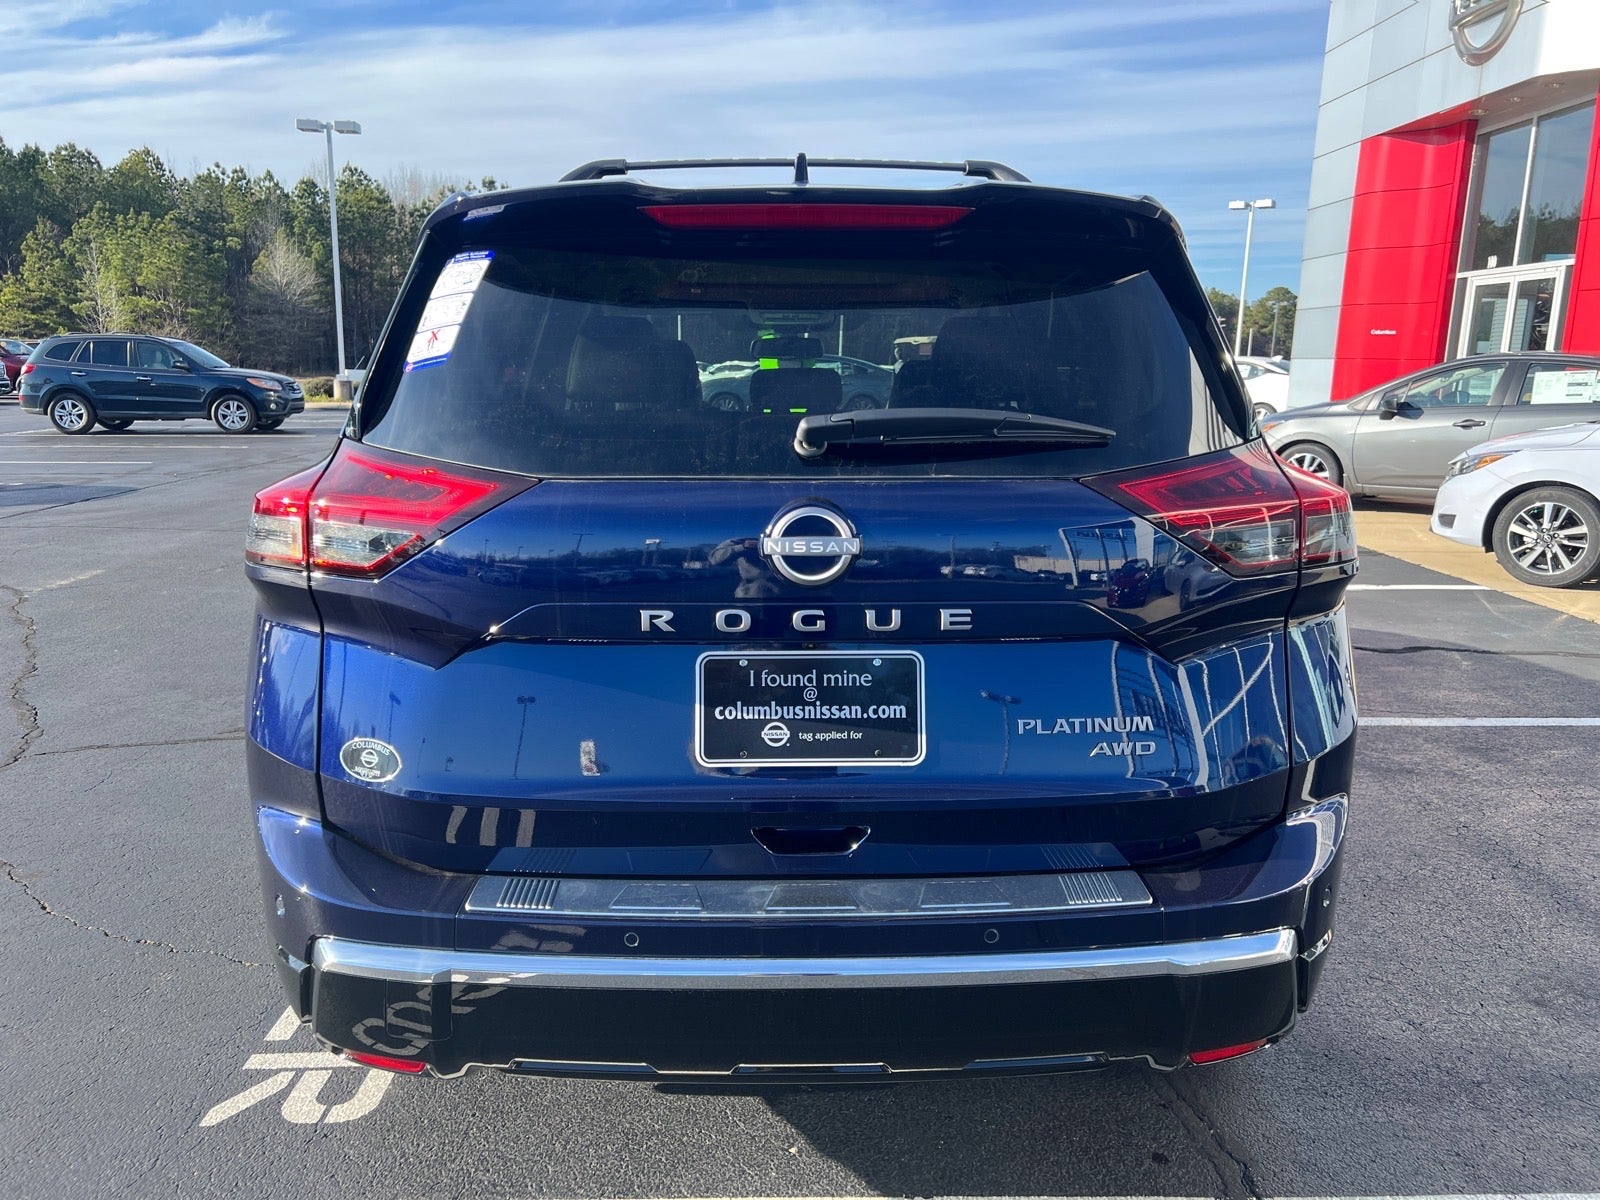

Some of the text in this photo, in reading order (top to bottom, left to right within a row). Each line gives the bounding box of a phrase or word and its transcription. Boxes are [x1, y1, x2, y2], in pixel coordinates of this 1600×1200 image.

[767, 540, 858, 553] NISSAN
[639, 608, 973, 632] ROGUE
[749, 669, 873, 687] I found mine
[803, 687, 818, 702] @
[714, 701, 907, 720] columbusnissan.com
[1017, 715, 1154, 735] PLATINUM
[798, 730, 863, 741] tag applied for
[352, 741, 391, 756] COLUMBUS
[1089, 741, 1156, 757] AWD
